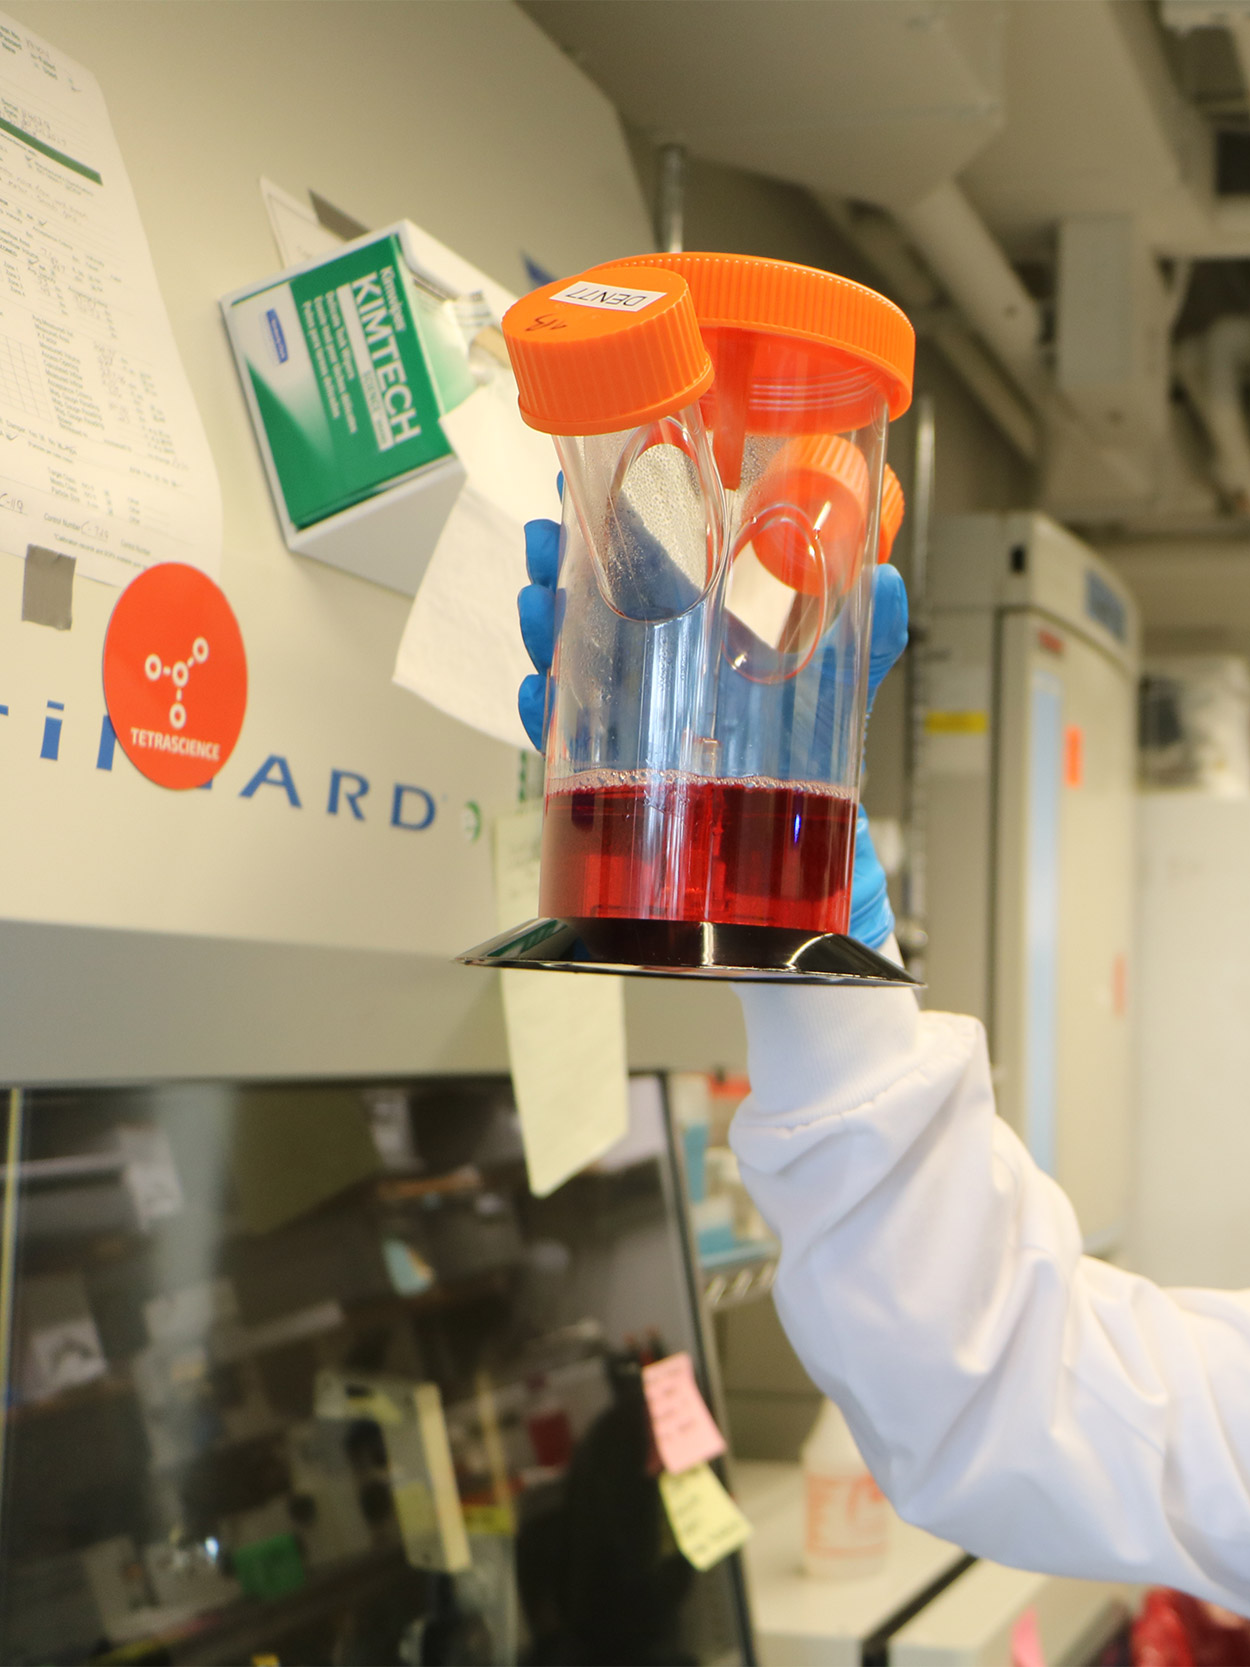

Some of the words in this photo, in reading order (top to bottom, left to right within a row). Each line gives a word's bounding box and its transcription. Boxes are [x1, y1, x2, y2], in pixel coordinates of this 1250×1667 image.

[565, 287, 648, 307] DEN77
[350, 271, 421, 442] KIMTECH
[131, 728, 220, 762] TETRASCIENCE
